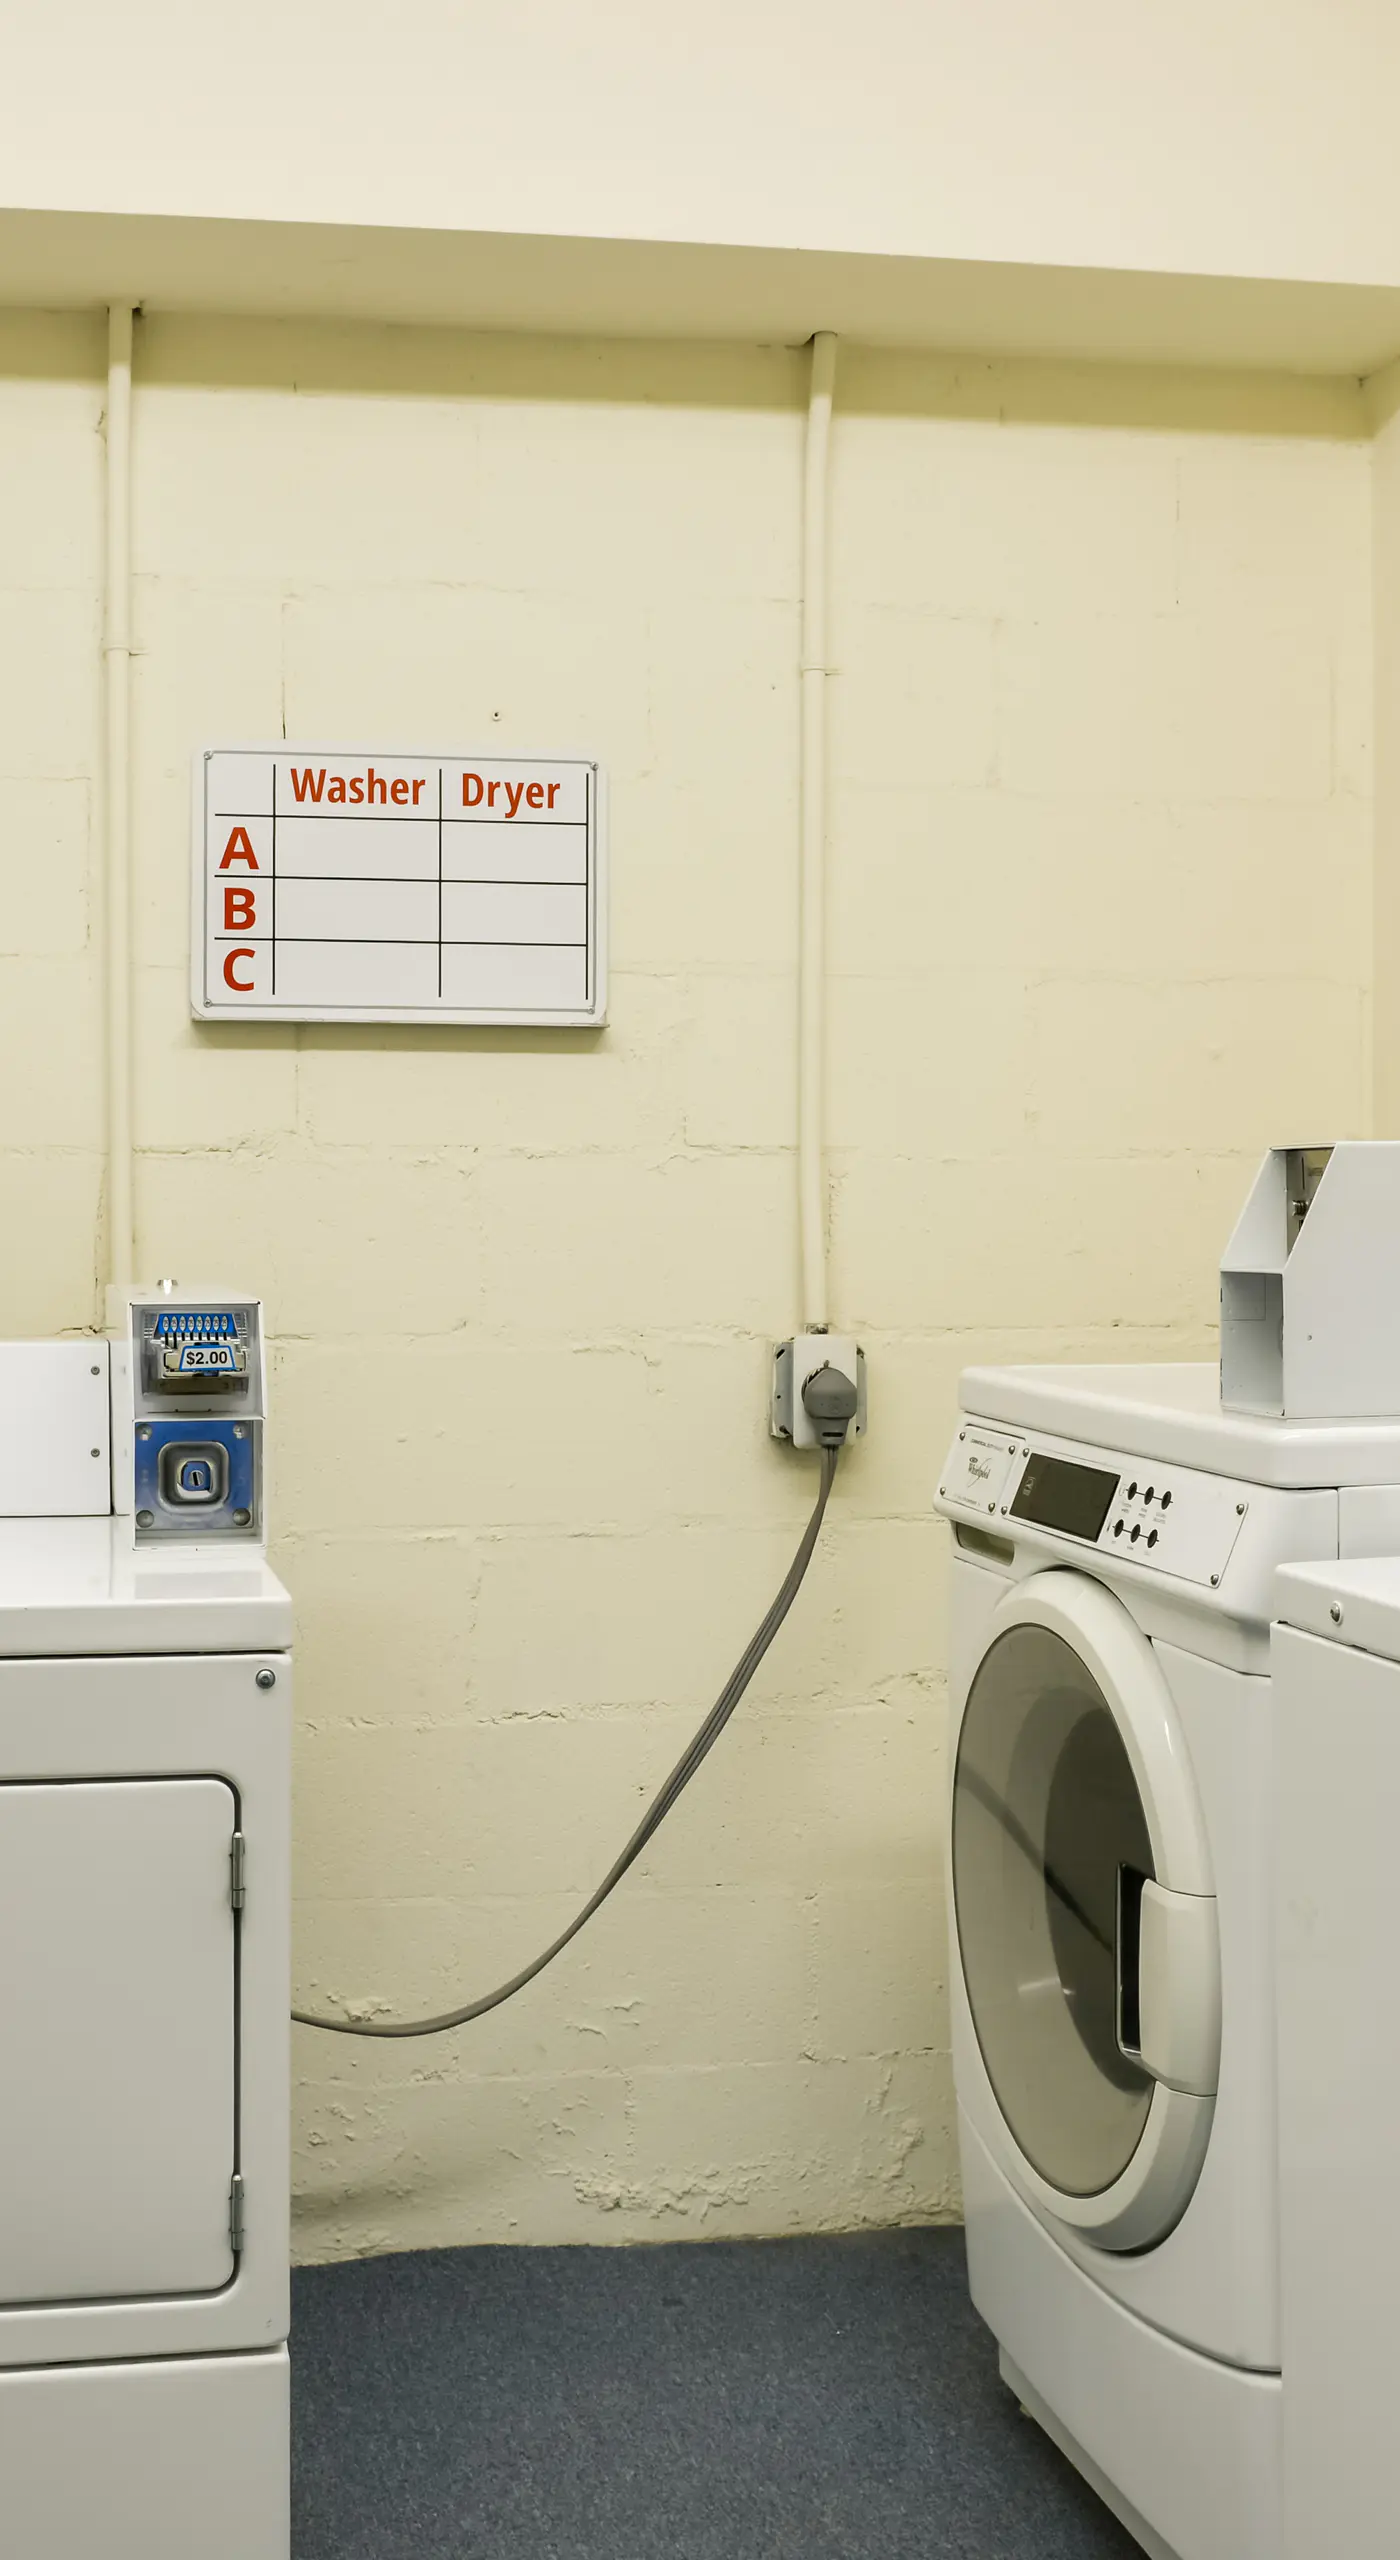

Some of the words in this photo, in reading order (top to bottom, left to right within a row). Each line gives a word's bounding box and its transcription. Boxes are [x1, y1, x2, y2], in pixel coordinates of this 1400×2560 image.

[290, 767, 427, 807] Washer
[461, 772, 561, 819] Dryer
[218, 826, 260, 870] A
[223, 887, 257, 931] B
[222, 948, 256, 992] C
[186, 1351, 228, 1366] $2.00
